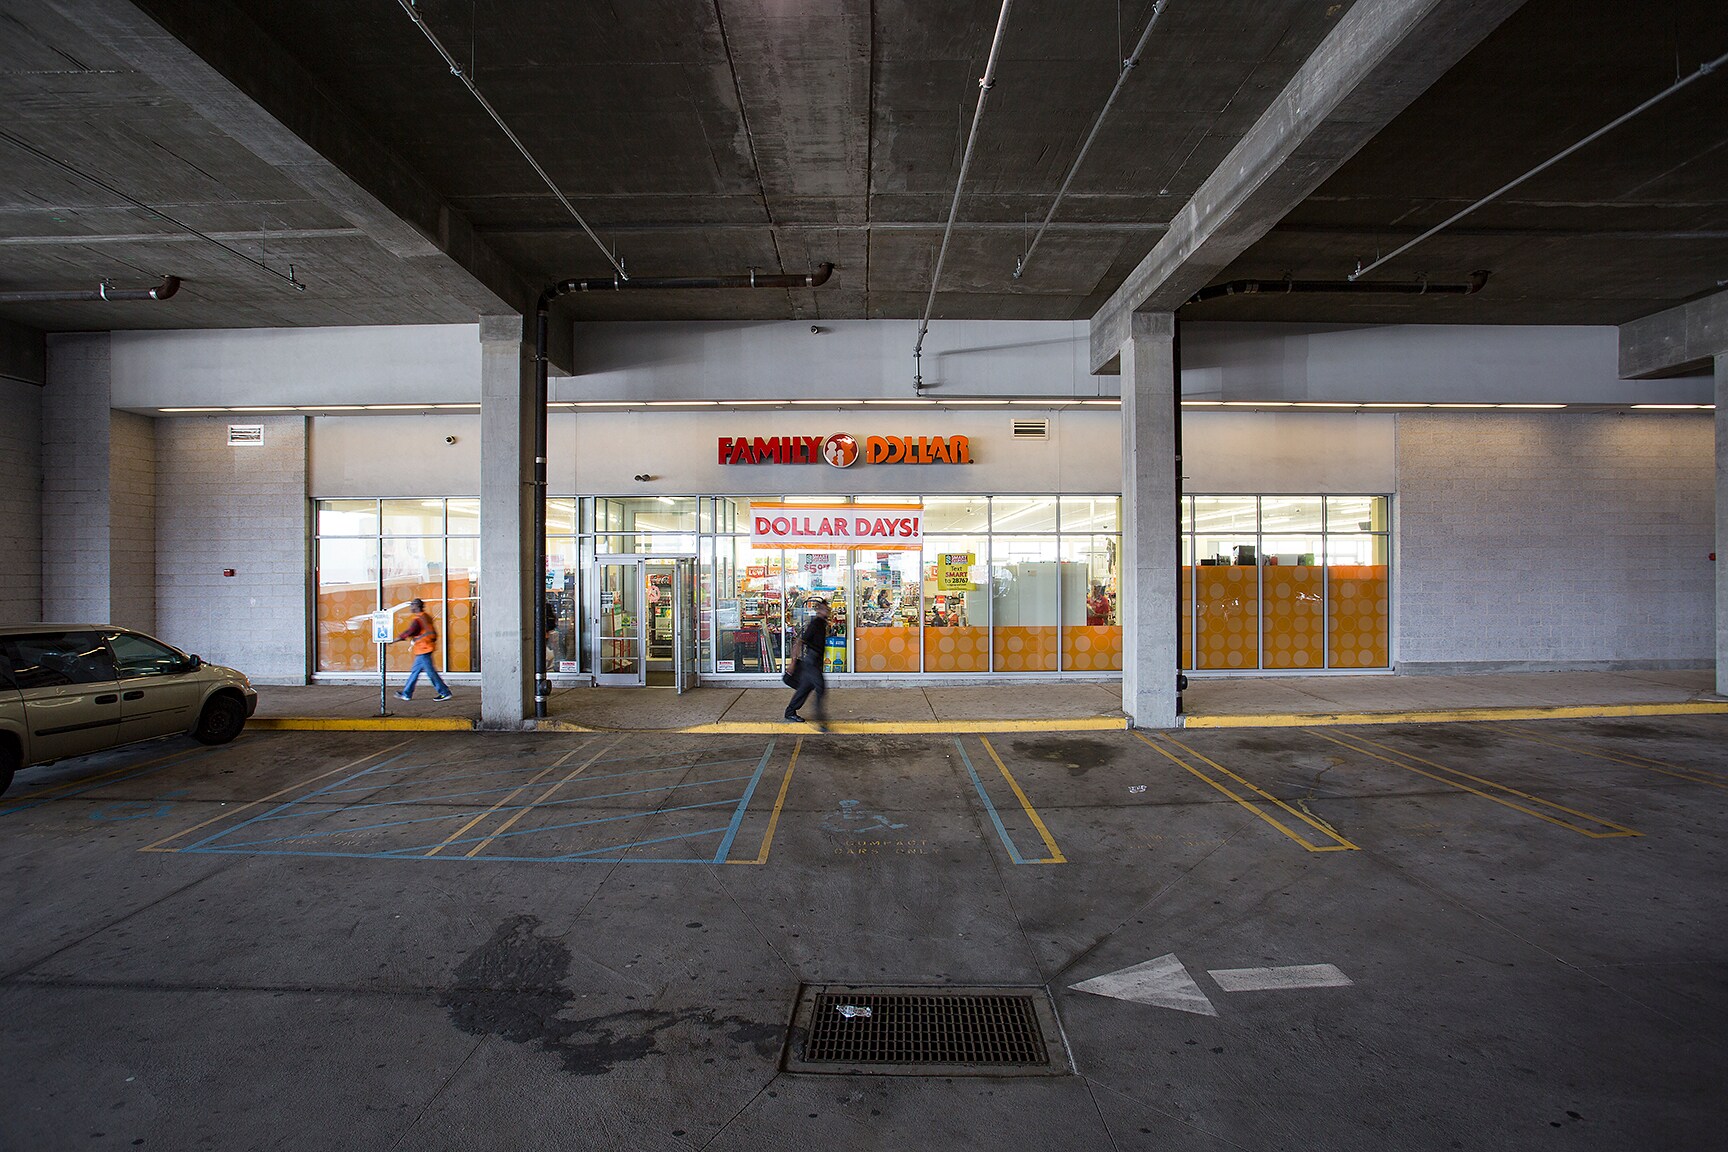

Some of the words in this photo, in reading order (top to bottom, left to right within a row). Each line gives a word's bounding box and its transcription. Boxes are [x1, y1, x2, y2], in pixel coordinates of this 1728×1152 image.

[718, 436, 824, 465] FAMILY
[866, 435, 969, 465] DOLLAR
[755, 517, 849, 536] DOLLAR
[855, 517, 919, 537] DAYS!
